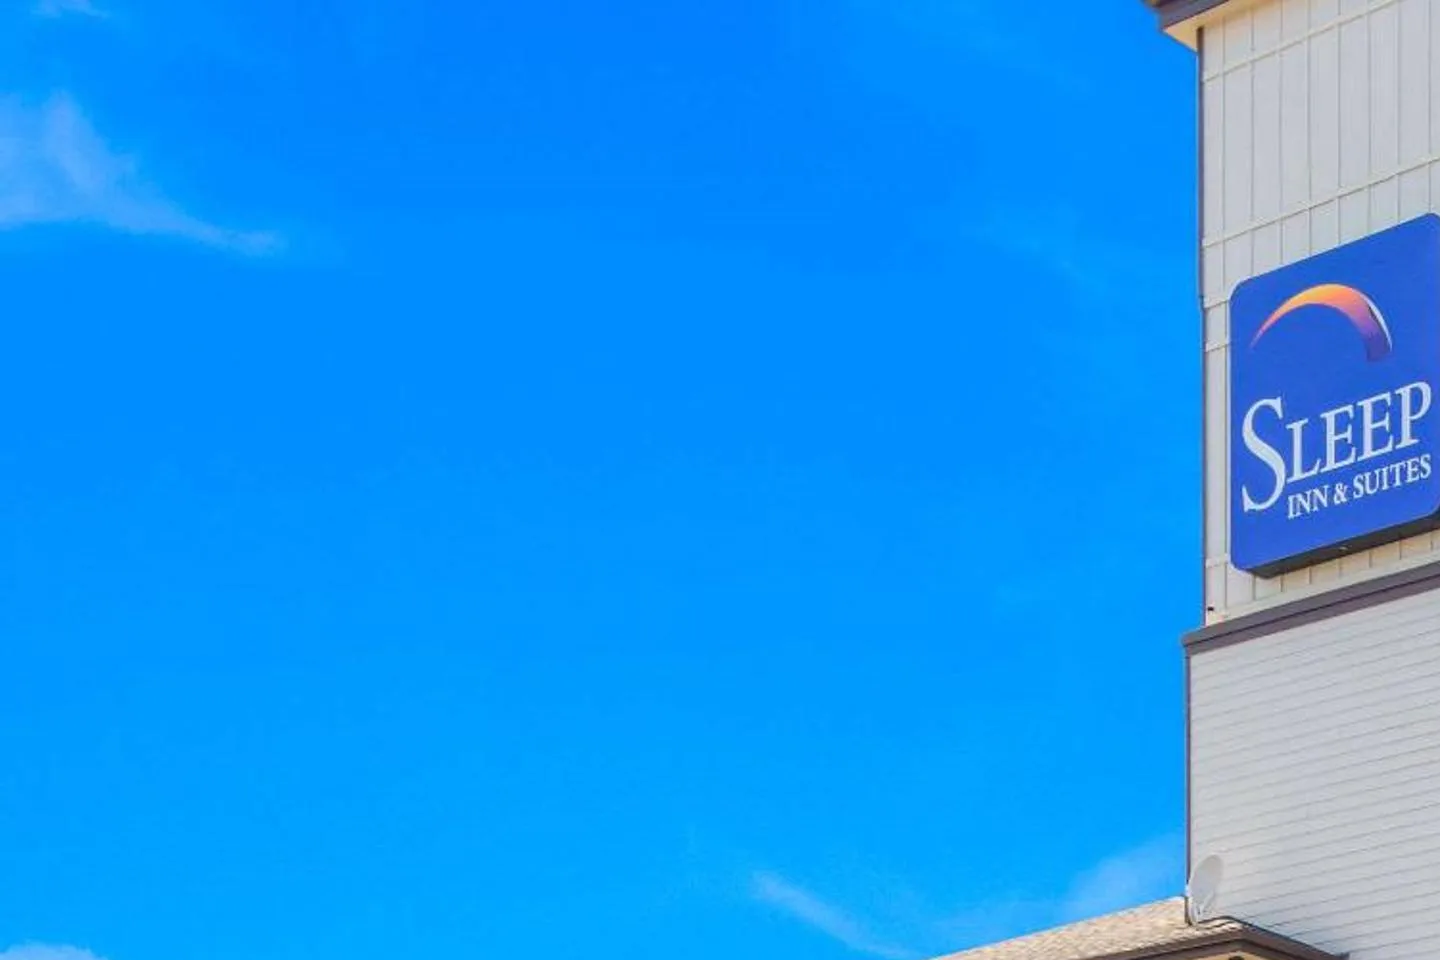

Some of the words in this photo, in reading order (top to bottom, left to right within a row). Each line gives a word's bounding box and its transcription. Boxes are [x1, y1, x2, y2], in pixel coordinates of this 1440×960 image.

[1242, 381, 1431, 512] SLEEP
[1287, 485, 1330, 519] INN
[1333, 482, 1349, 505] &
[1353, 454, 1431, 498] SUITES
